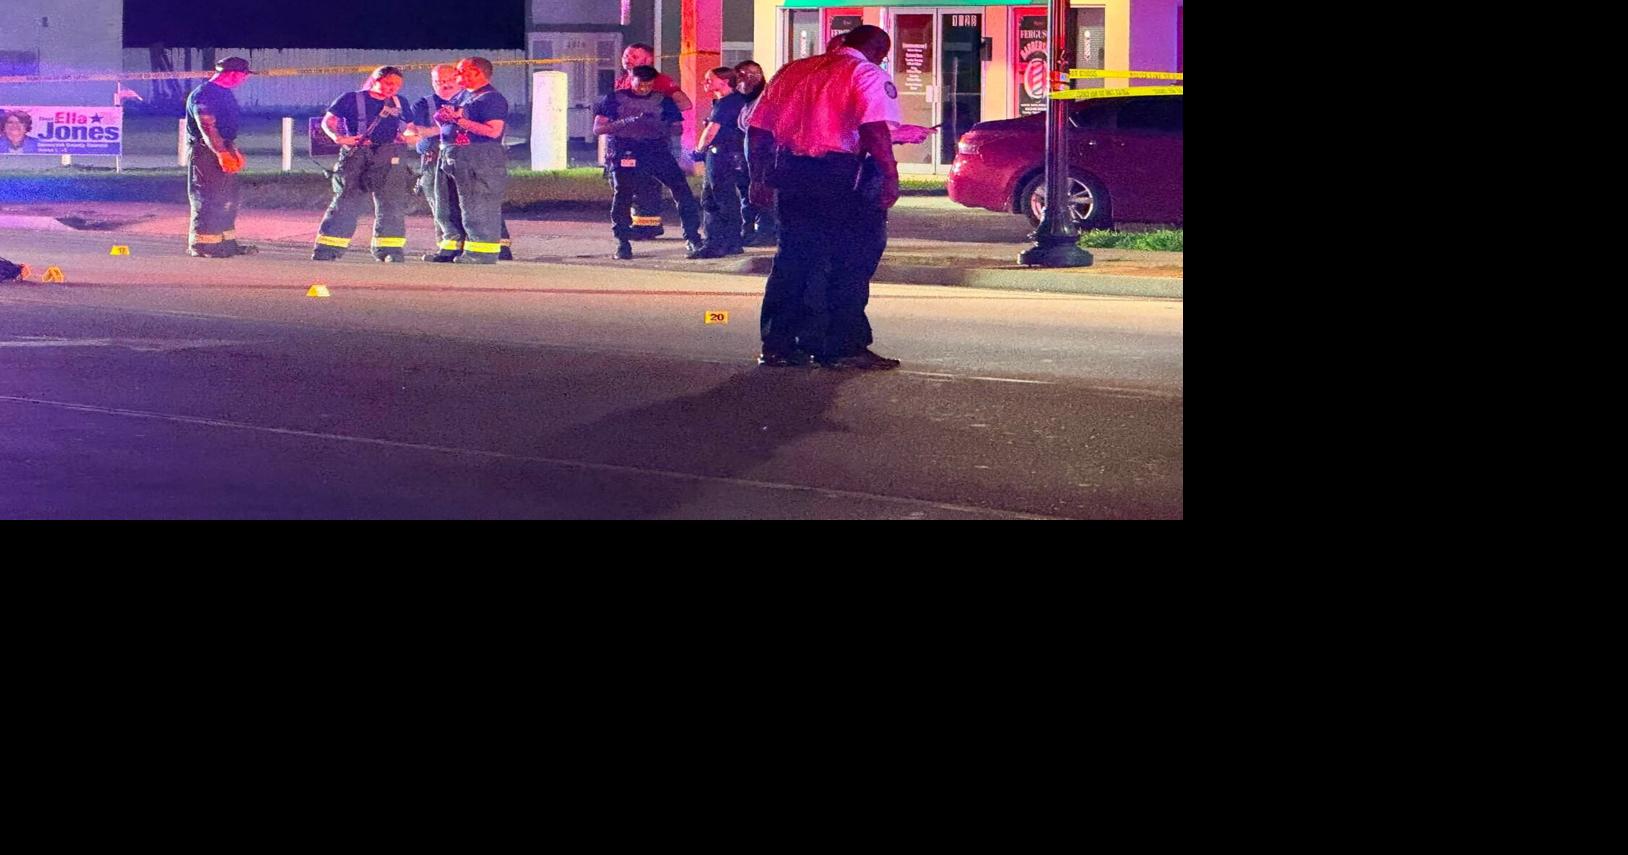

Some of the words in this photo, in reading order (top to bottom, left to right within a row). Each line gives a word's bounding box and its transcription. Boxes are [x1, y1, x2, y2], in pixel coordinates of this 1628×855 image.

[1020, 30, 1047, 39] FERGUS
[55, 112, 87, 124] Ella
[37, 121, 119, 140] Jones
[710, 313, 724, 321] 20
